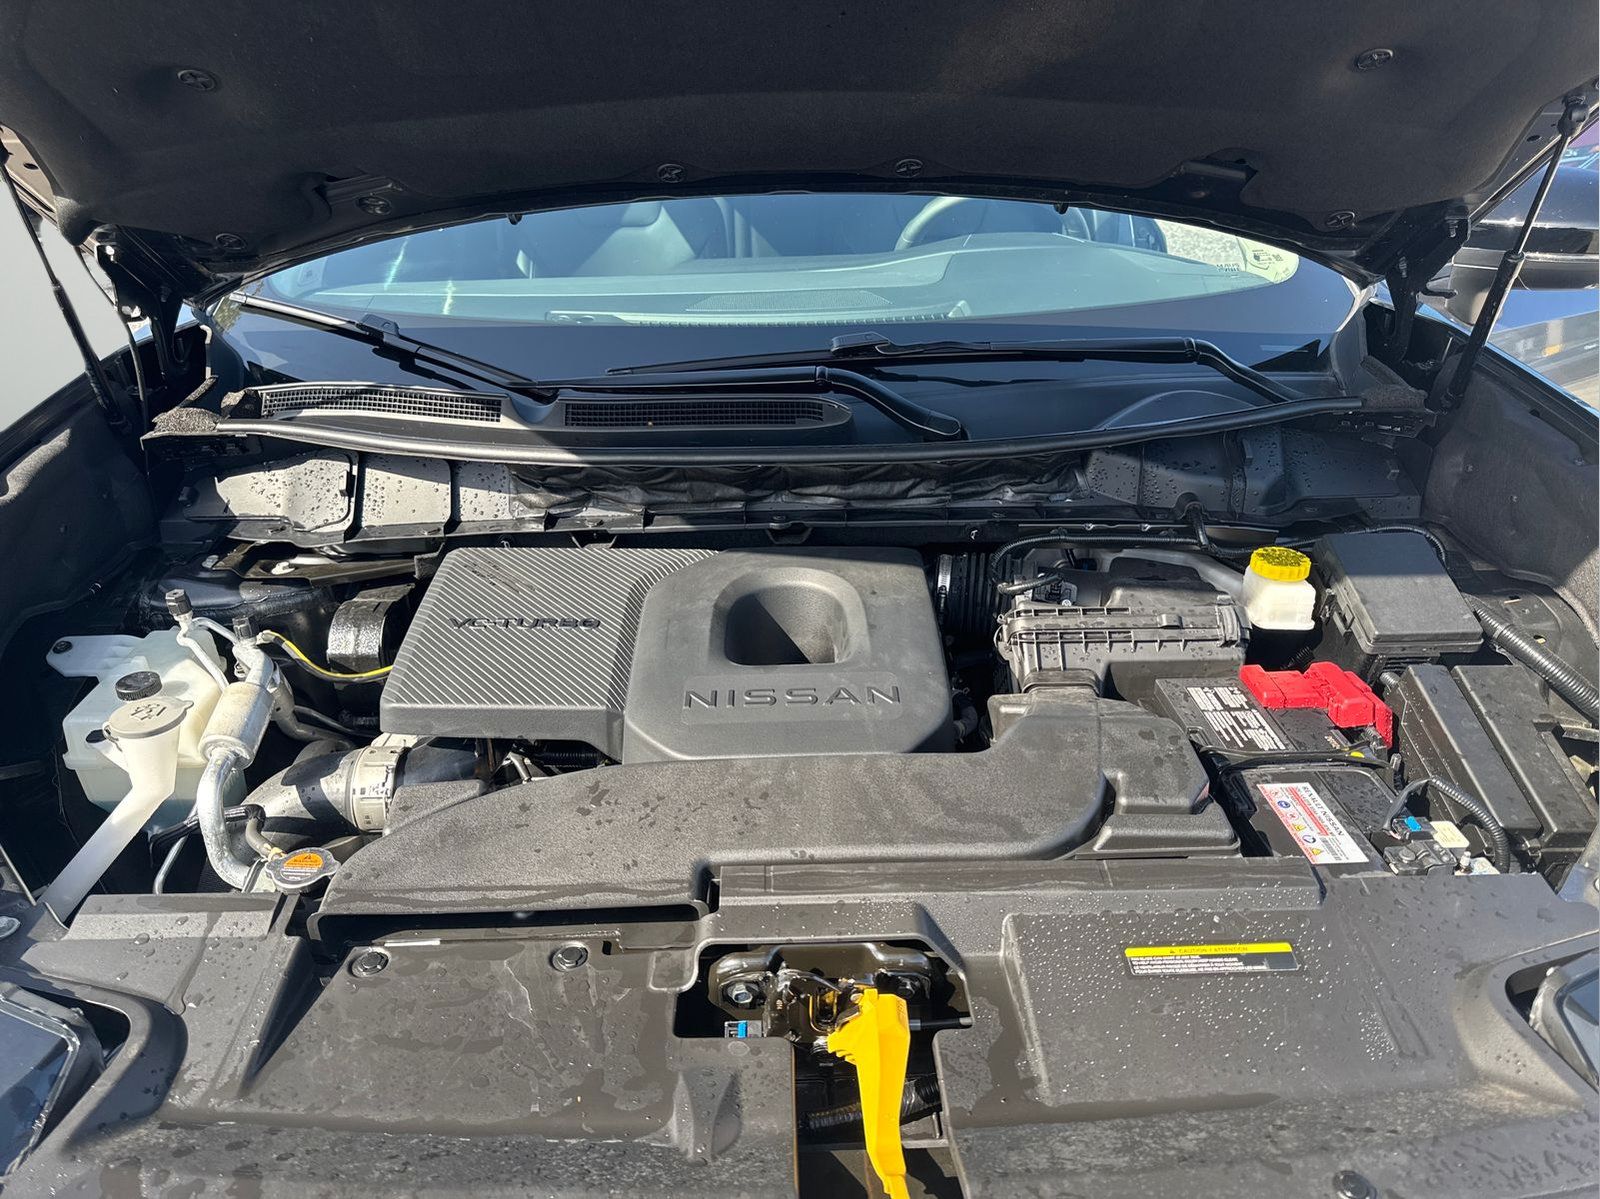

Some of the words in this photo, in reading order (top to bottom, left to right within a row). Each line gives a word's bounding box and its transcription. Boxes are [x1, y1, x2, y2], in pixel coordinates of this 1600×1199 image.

[449, 617, 601, 629] VC-TURBO
[683, 686, 901, 709] NISSAN
[1321, 810, 1345, 836] NISSAN
